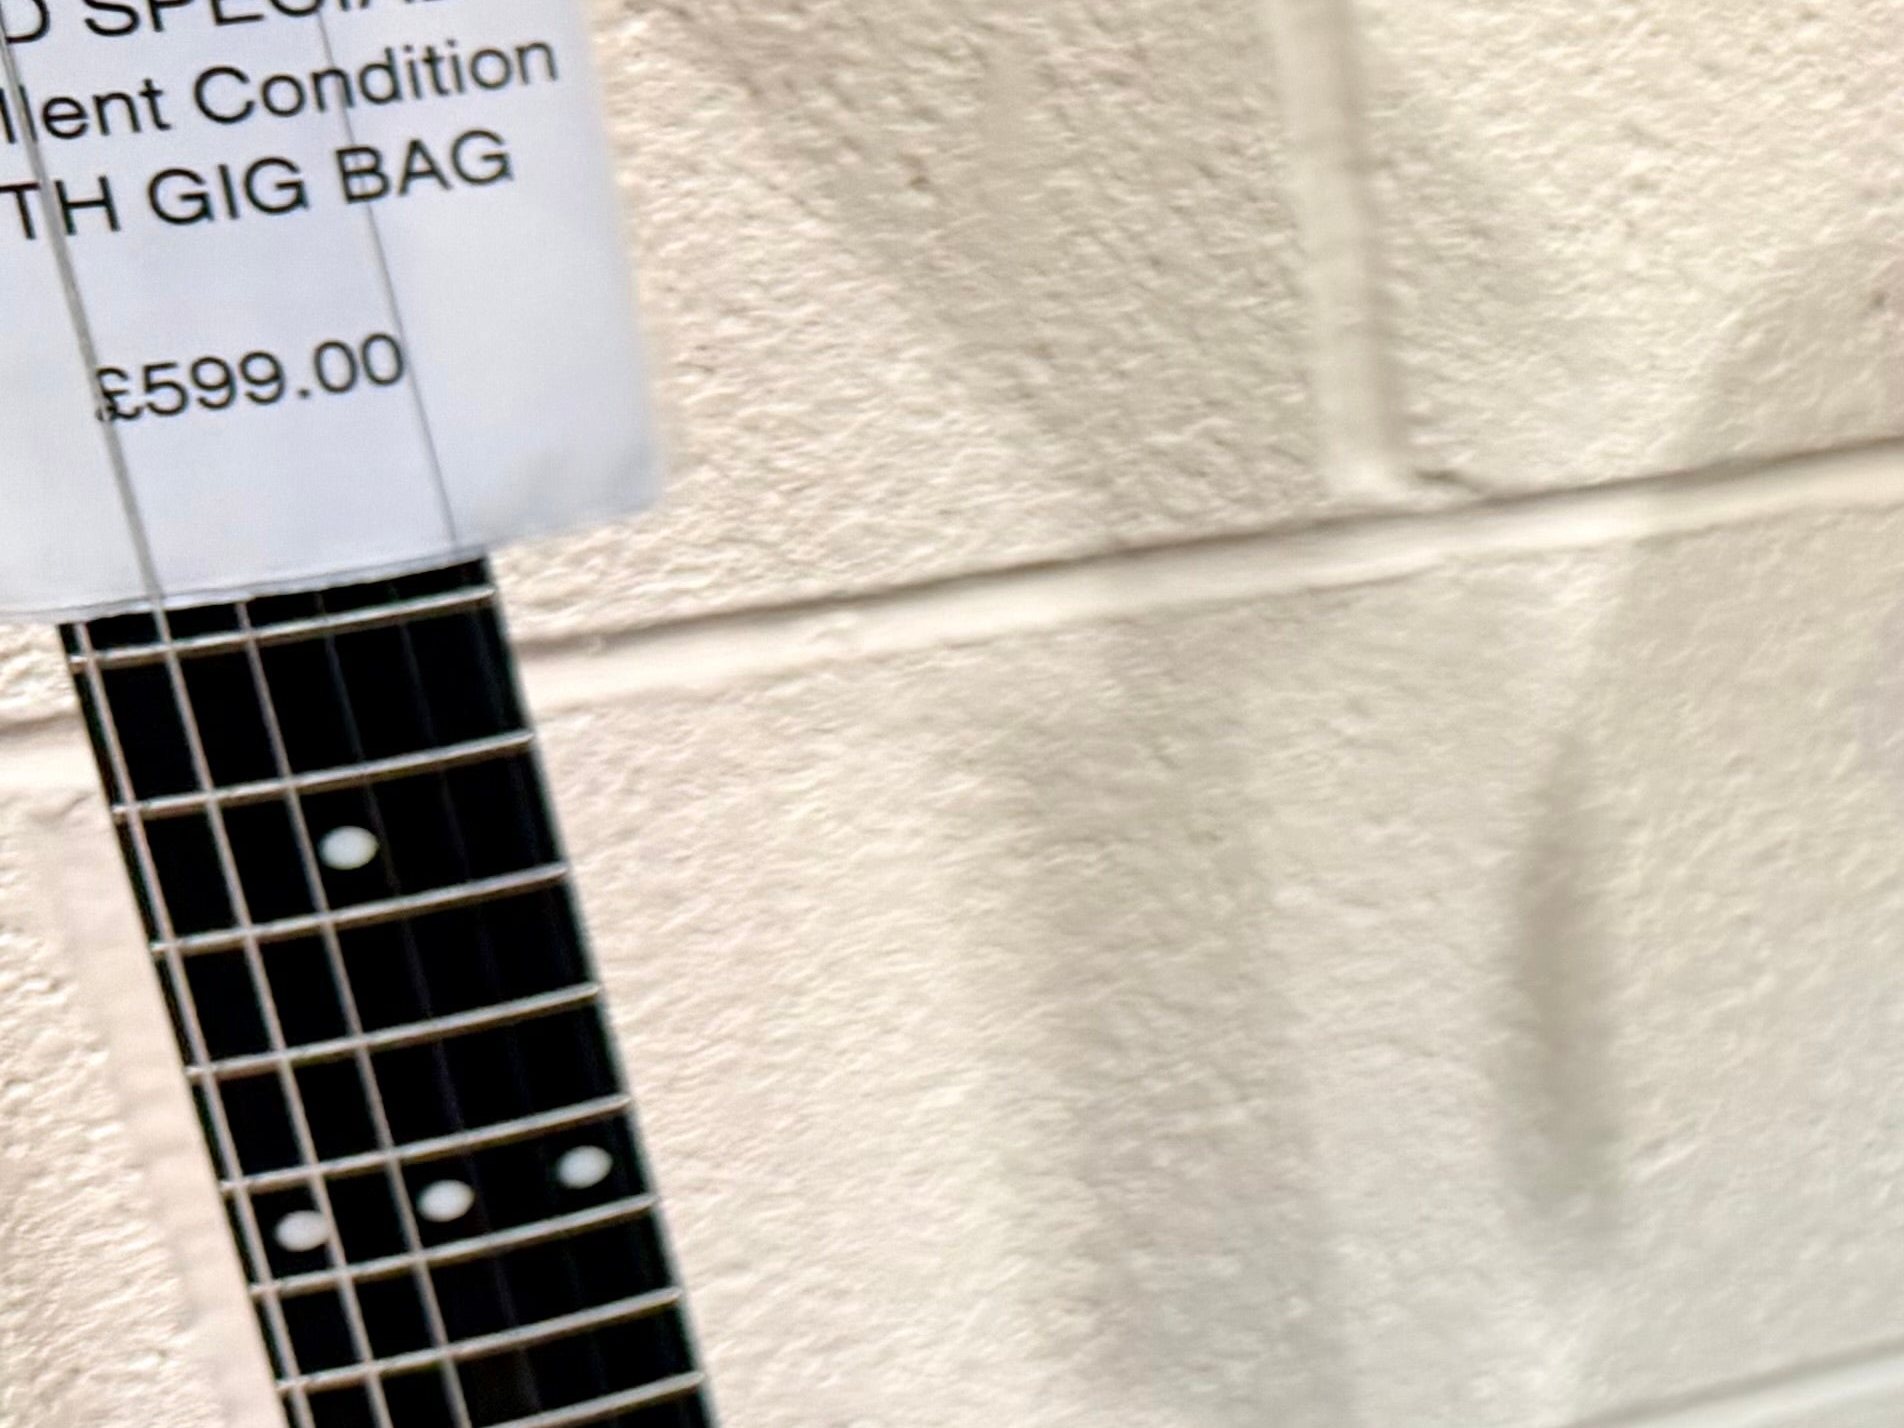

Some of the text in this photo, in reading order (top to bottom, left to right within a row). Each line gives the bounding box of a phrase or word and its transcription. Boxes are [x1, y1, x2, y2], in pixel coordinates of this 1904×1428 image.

[193, 39, 560, 126] Condition
[147, 156, 312, 227] GIG
[335, 129, 516, 206] BAG
[95, 332, 407, 423] £599.00
